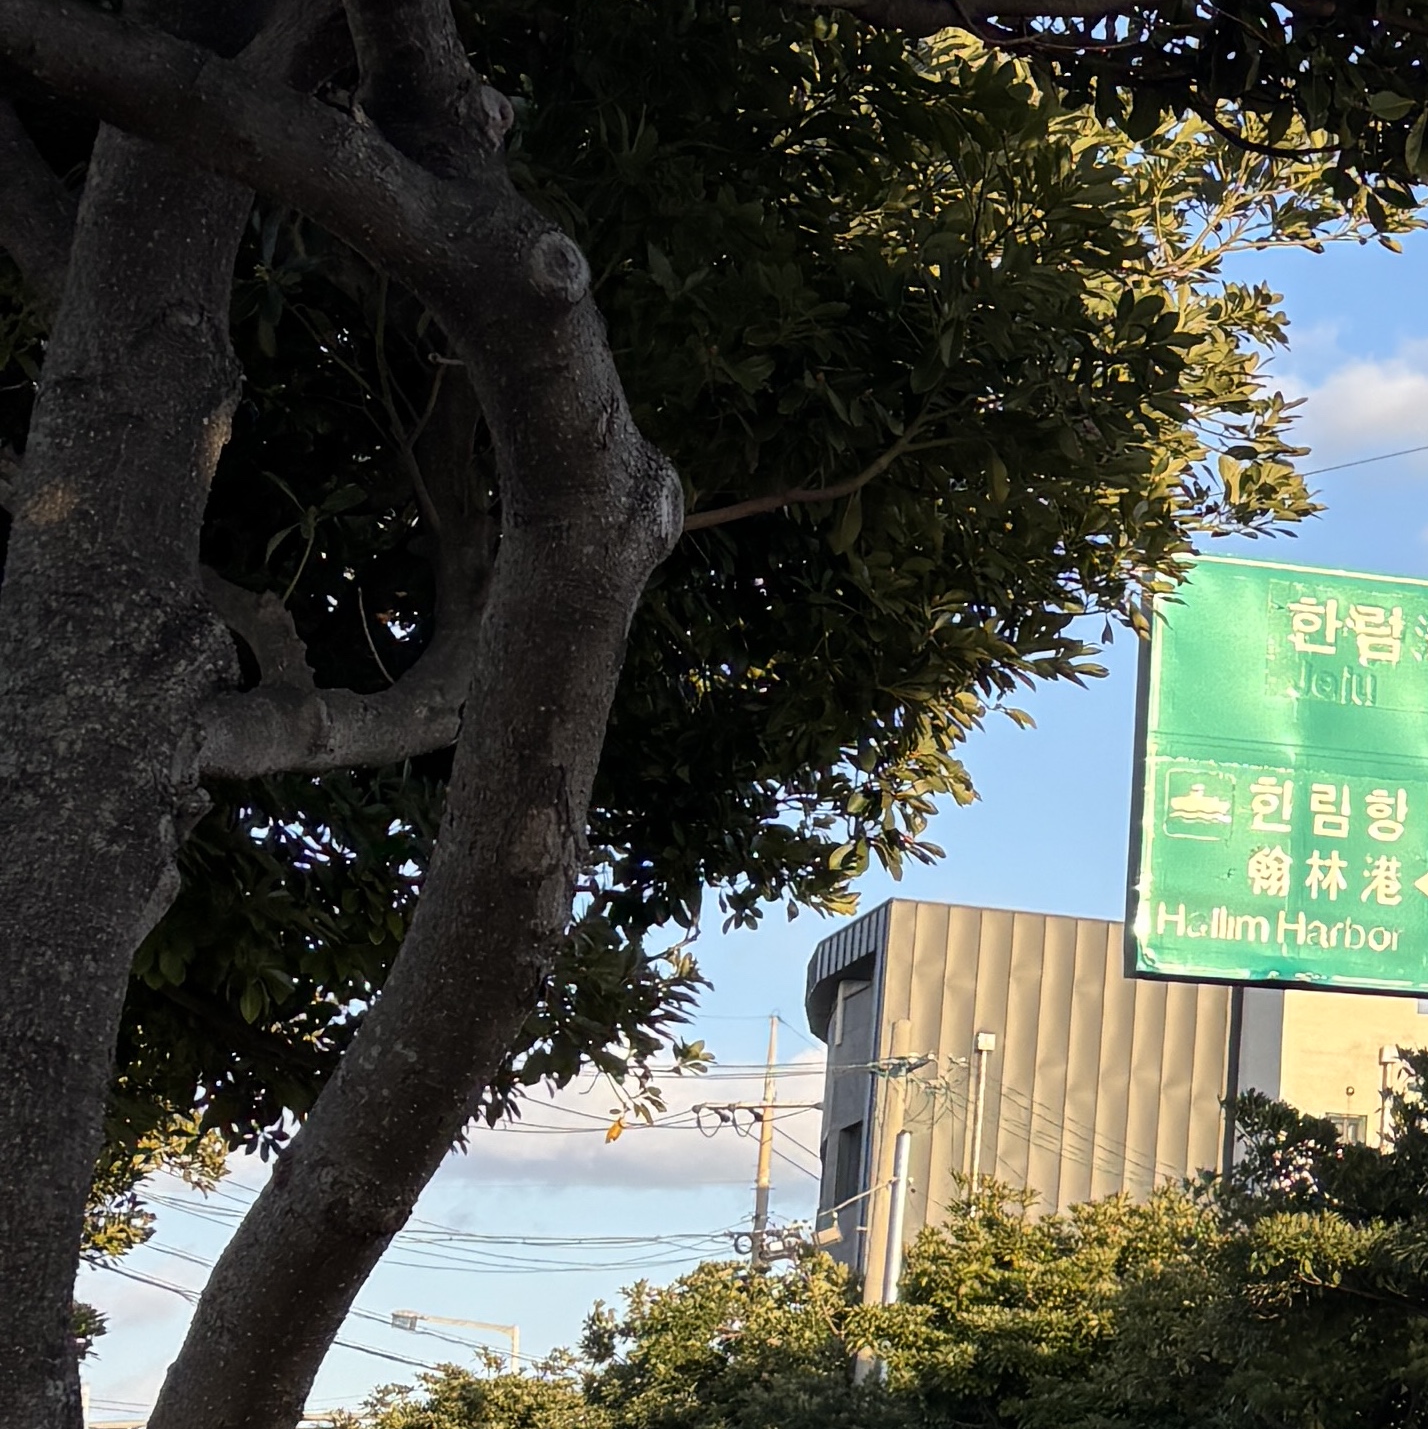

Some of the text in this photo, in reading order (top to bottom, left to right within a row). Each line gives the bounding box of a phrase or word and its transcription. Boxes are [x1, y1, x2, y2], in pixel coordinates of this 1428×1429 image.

[1249, 776, 1408, 842] 한림항
[1247, 845, 1403, 907] 翰林港
[1157, 902, 1403, 952] Hallim Harbor
